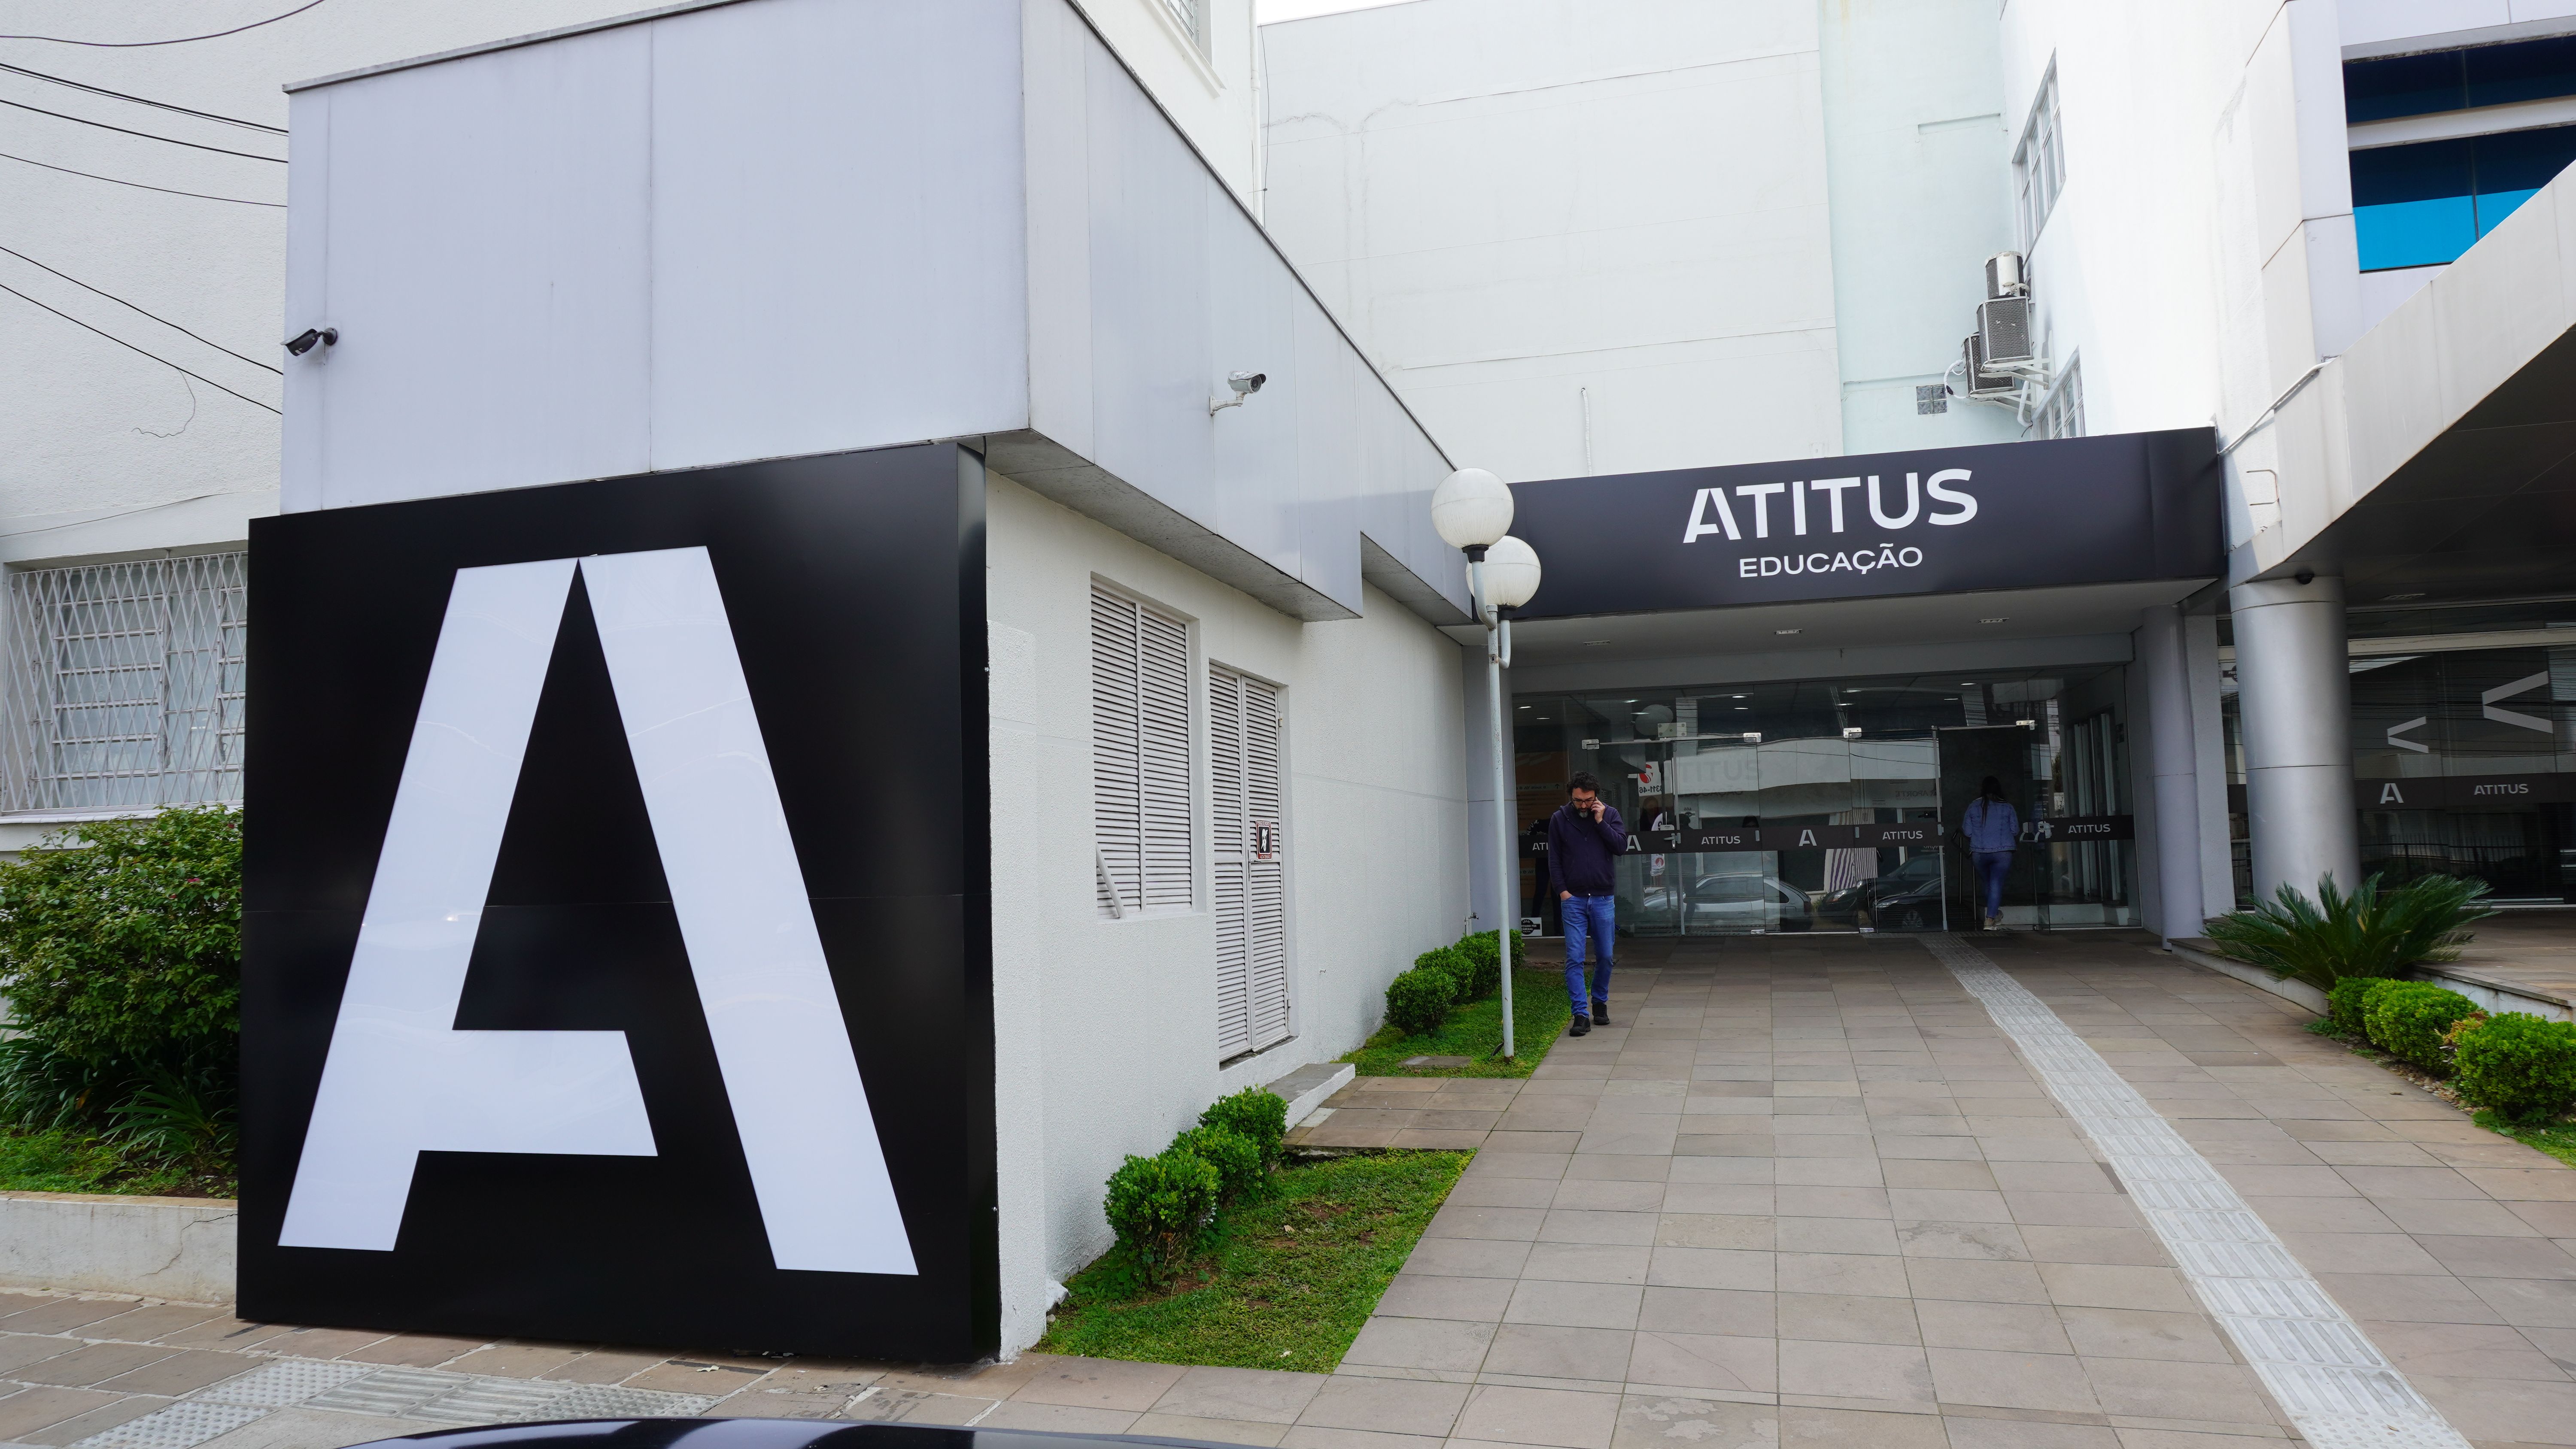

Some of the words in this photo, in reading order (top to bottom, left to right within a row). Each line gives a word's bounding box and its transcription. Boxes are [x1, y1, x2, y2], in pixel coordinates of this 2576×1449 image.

[1683, 469, 1978, 543] ATITUS
[1740, 543, 1923, 578] EDUCAÇÃO
[2380, 783, 2404, 804] A
[2474, 783, 2528, 795] ATITUS
[1532, 843, 1548, 851] ATI
[1626, 835, 1641, 851] A
[1701, 836, 1741, 845] ATITUS
[1799, 829, 1817, 846] A
[1882, 831, 1923, 840] ATITUS
[2068, 824, 2111, 834] ATITUS
[279, 546, 918, 1275] A
